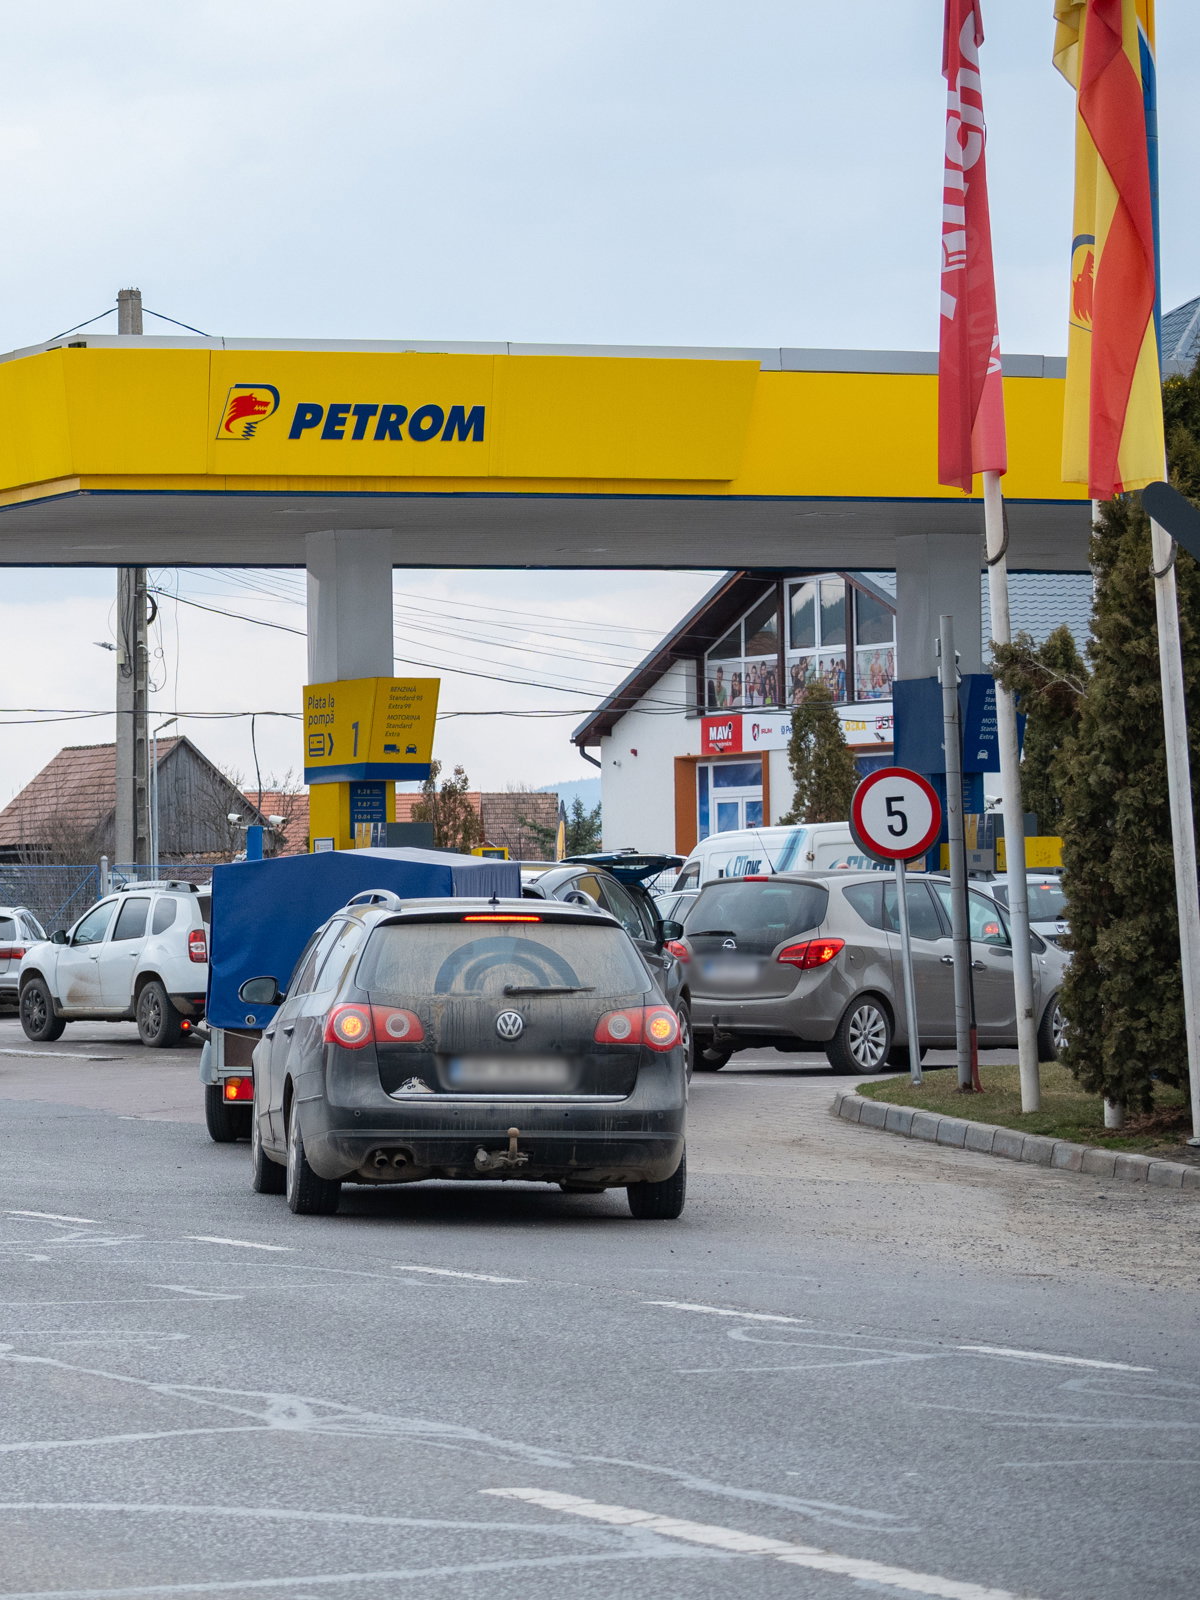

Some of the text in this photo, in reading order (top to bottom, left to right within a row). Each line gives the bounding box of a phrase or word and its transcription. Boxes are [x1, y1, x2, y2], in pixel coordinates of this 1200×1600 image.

[287, 403, 486, 442] PETROM
[308, 693, 335, 710] Plata la
[308, 710, 335, 728] pompă
[352, 721, 359, 757] 1
[885, 796, 908, 837] 5
